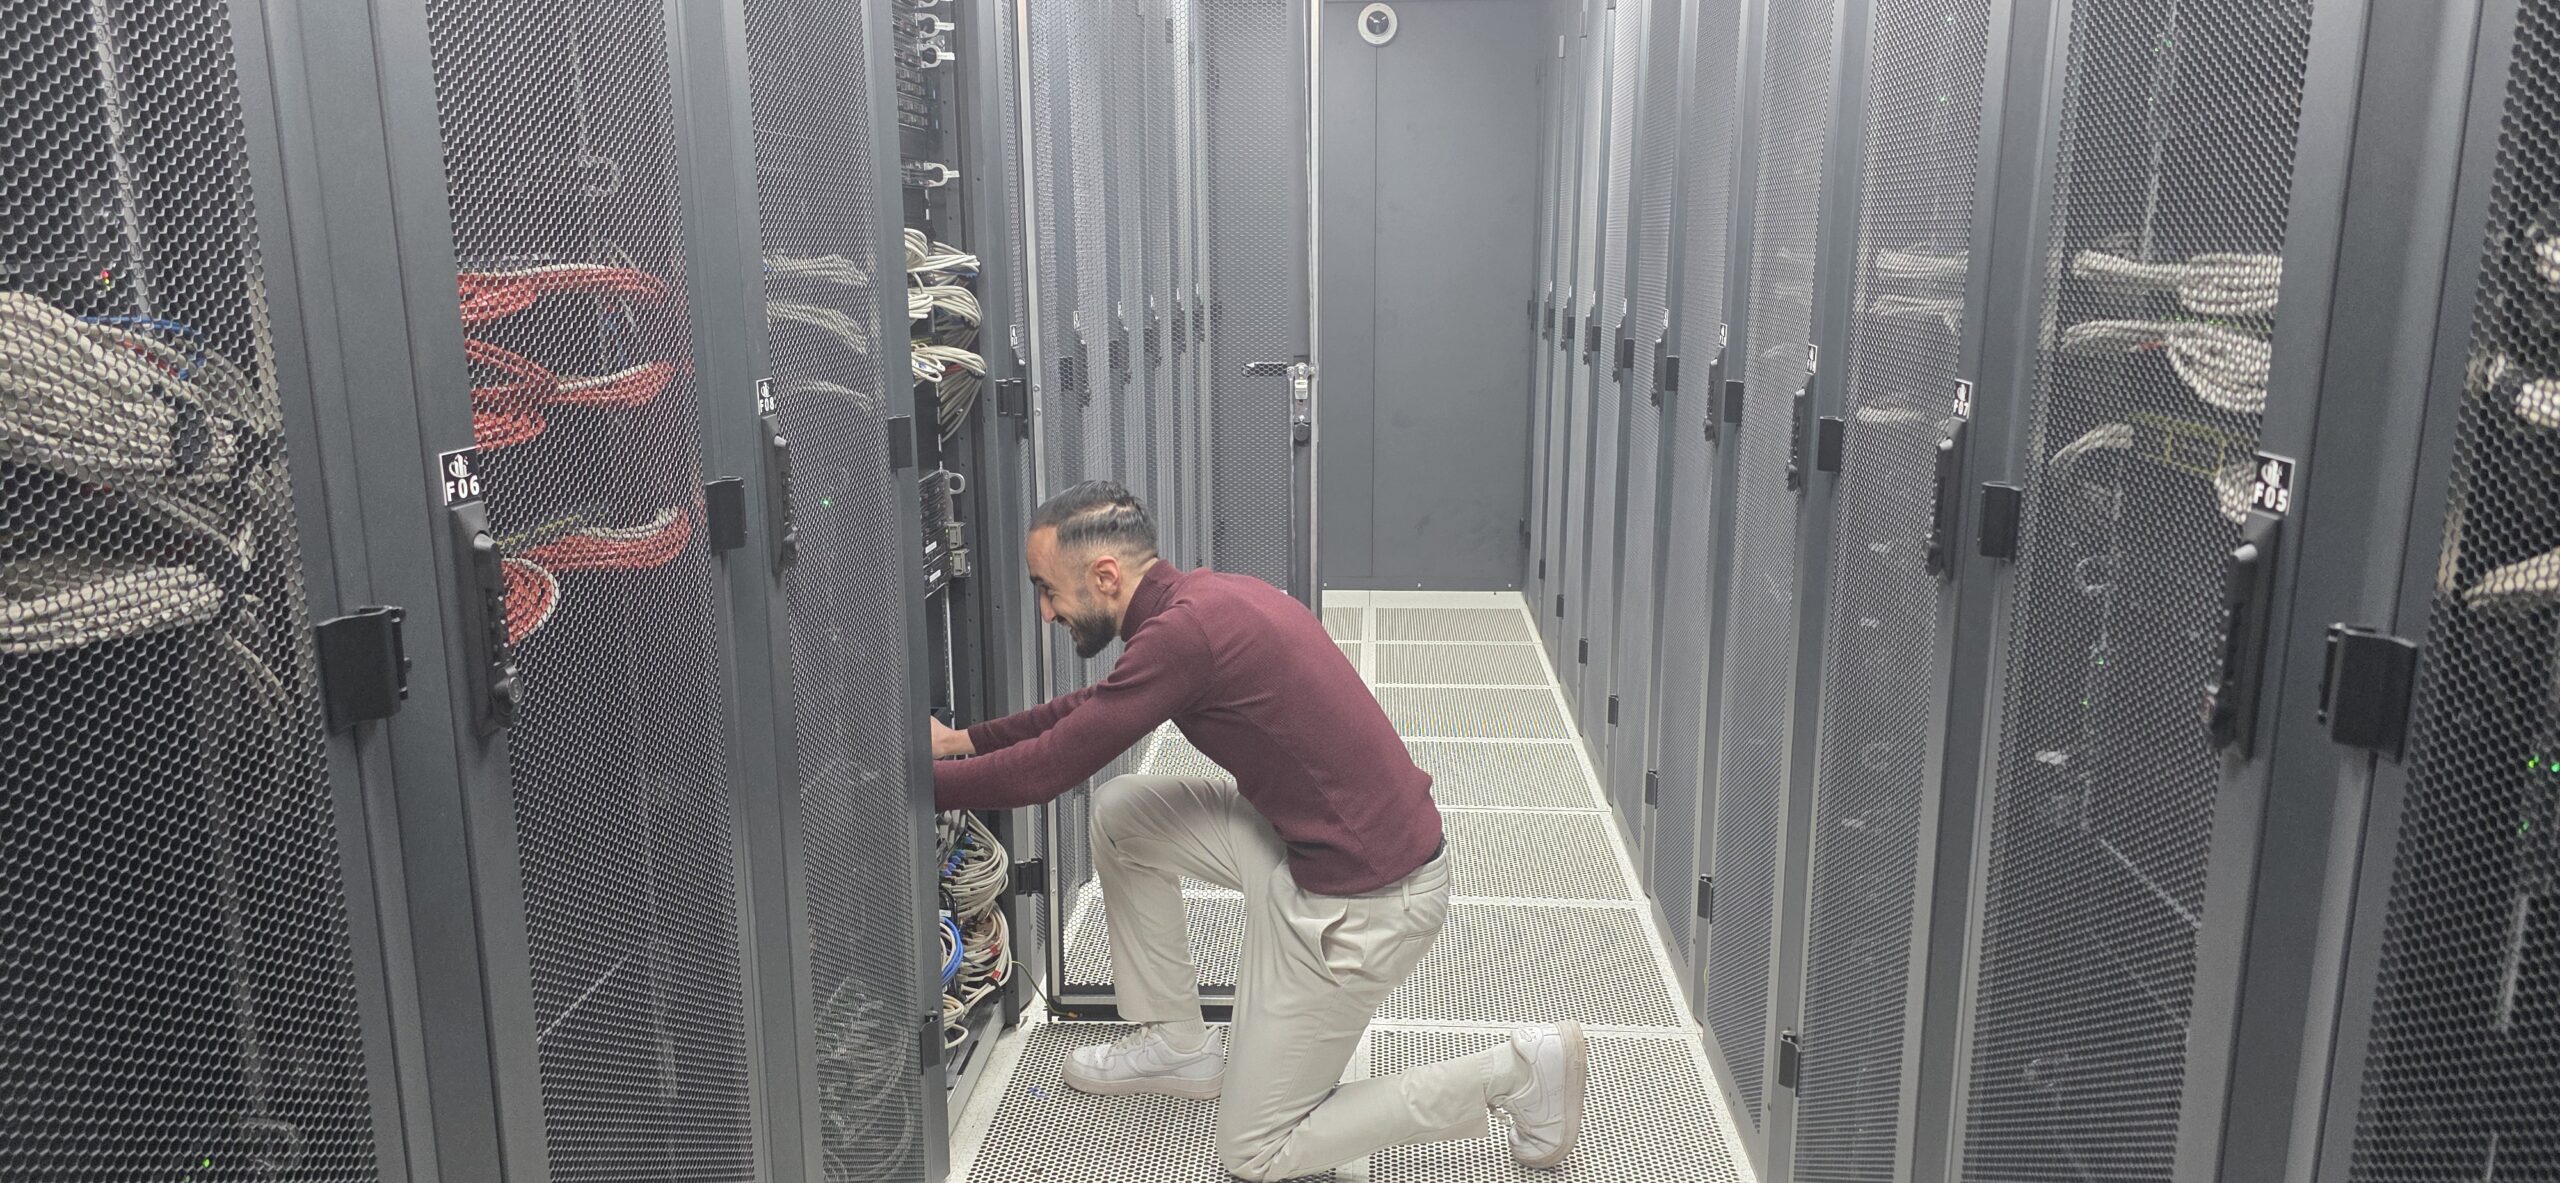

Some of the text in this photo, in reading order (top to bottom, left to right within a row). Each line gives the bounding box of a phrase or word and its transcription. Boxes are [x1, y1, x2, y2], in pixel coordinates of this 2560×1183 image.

[759, 396, 775, 414] F08
[1953, 398, 1969, 417] F07
[446, 474, 480, 502] F06
[2252, 481, 2289, 513] F05
